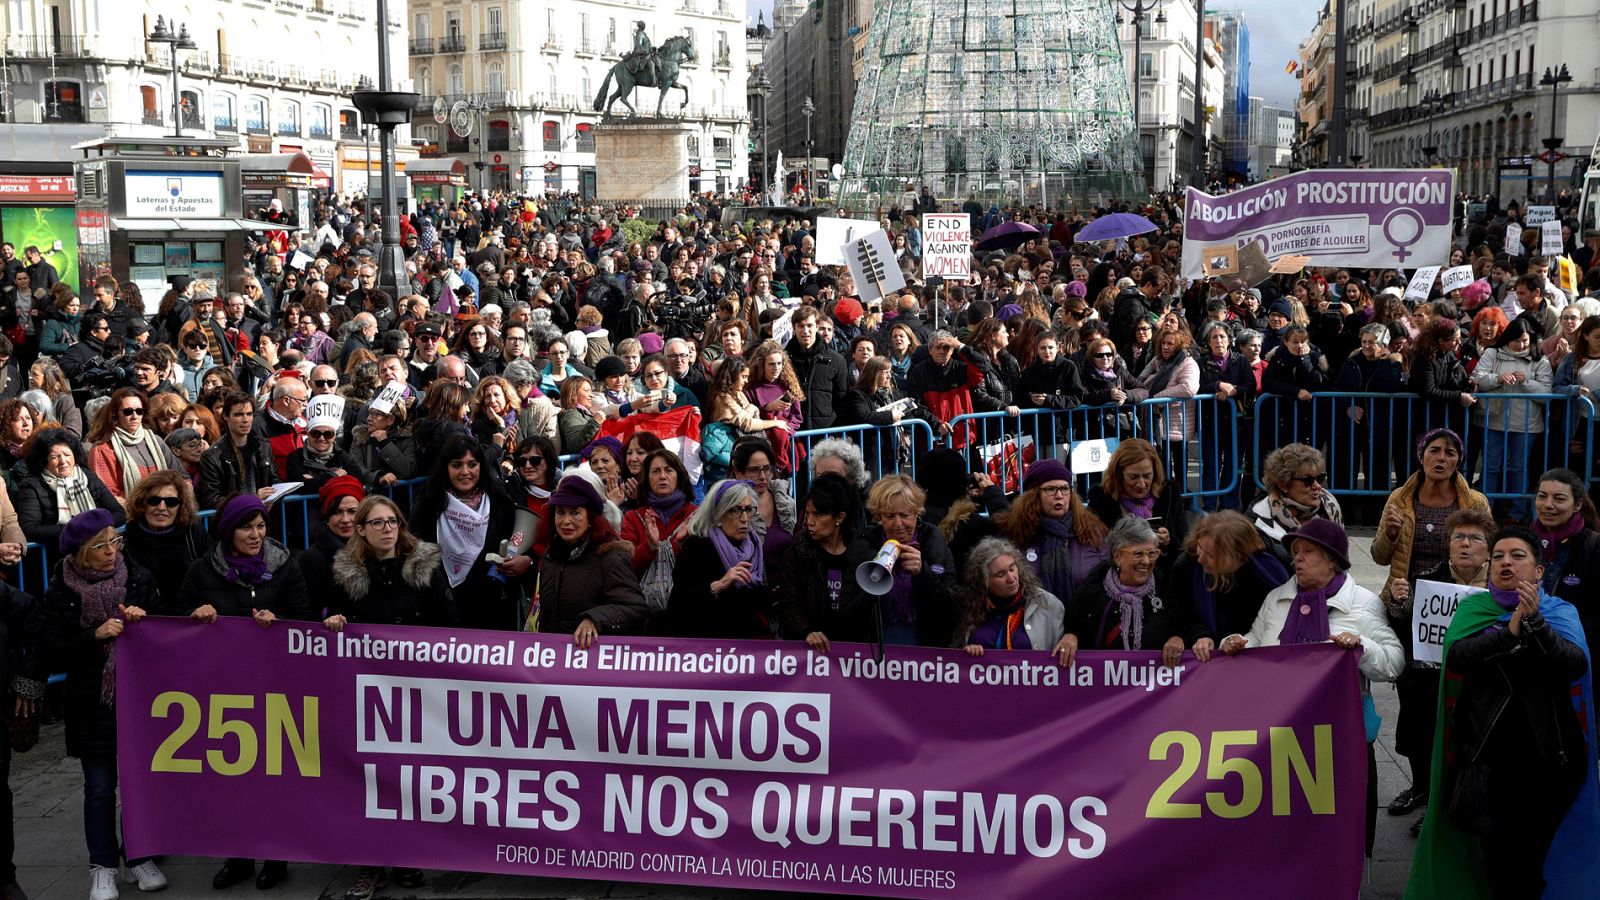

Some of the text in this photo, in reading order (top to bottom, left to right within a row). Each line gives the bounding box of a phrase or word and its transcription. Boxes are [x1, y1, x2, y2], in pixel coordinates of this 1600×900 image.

[178, 197, 213, 205] Apuestas
[1190, 177, 1446, 223] ABOLICIÓN PROSTITUCIÓN
[927, 219, 961, 230] END
[1271, 223, 1331, 242] PORNOGRAFÍA
[924, 231, 969, 243] VIOLENCE
[1271, 235, 1366, 253] VIENTRES DE ALQUILER
[927, 243, 968, 254] AGAINST
[924, 256, 969, 274] WOMEN
[827, 580, 842, 590] NO
[288, 628, 1186, 692] Día Internacional de la Eliminación de la violencia contra la Mujer
[363, 684, 822, 764] NI UNA MENOS
[151, 691, 321, 777] 25N
[1145, 724, 1336, 819] 25N
[364, 763, 1108, 860] LIBRES NOS QUEREMOS
[496, 844, 956, 889] FORO DE MADRID CONTRA LA VIOLENCIA A LAS MUJERES
